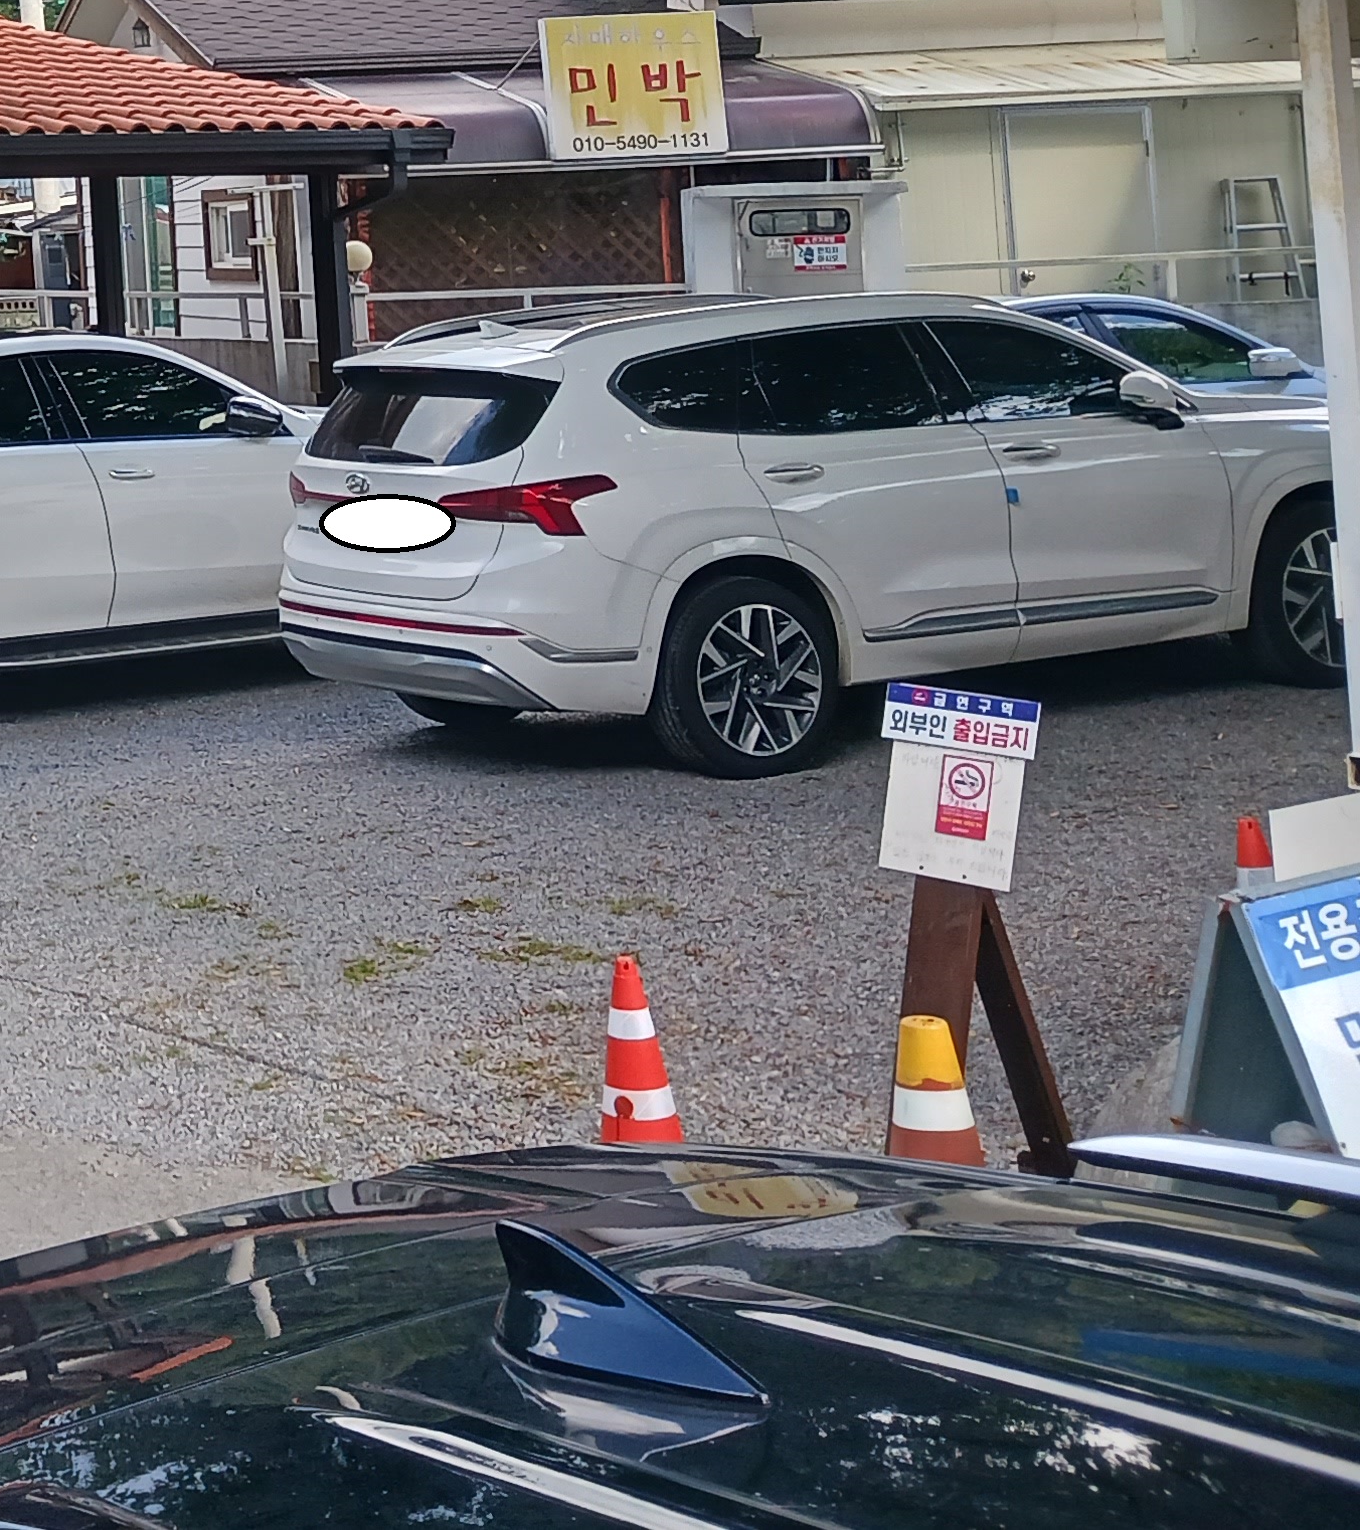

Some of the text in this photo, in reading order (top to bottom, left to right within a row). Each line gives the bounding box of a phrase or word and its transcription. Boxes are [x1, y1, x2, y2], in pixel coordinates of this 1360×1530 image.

[568, 60, 702, 127] 민박
[572, 132, 709, 153] 010-5490-1131
[933, 692, 1014, 717] 금연구역
[889, 709, 1029, 751] 외부인 출입금지
[1278, 899, 1360, 969] 전용
